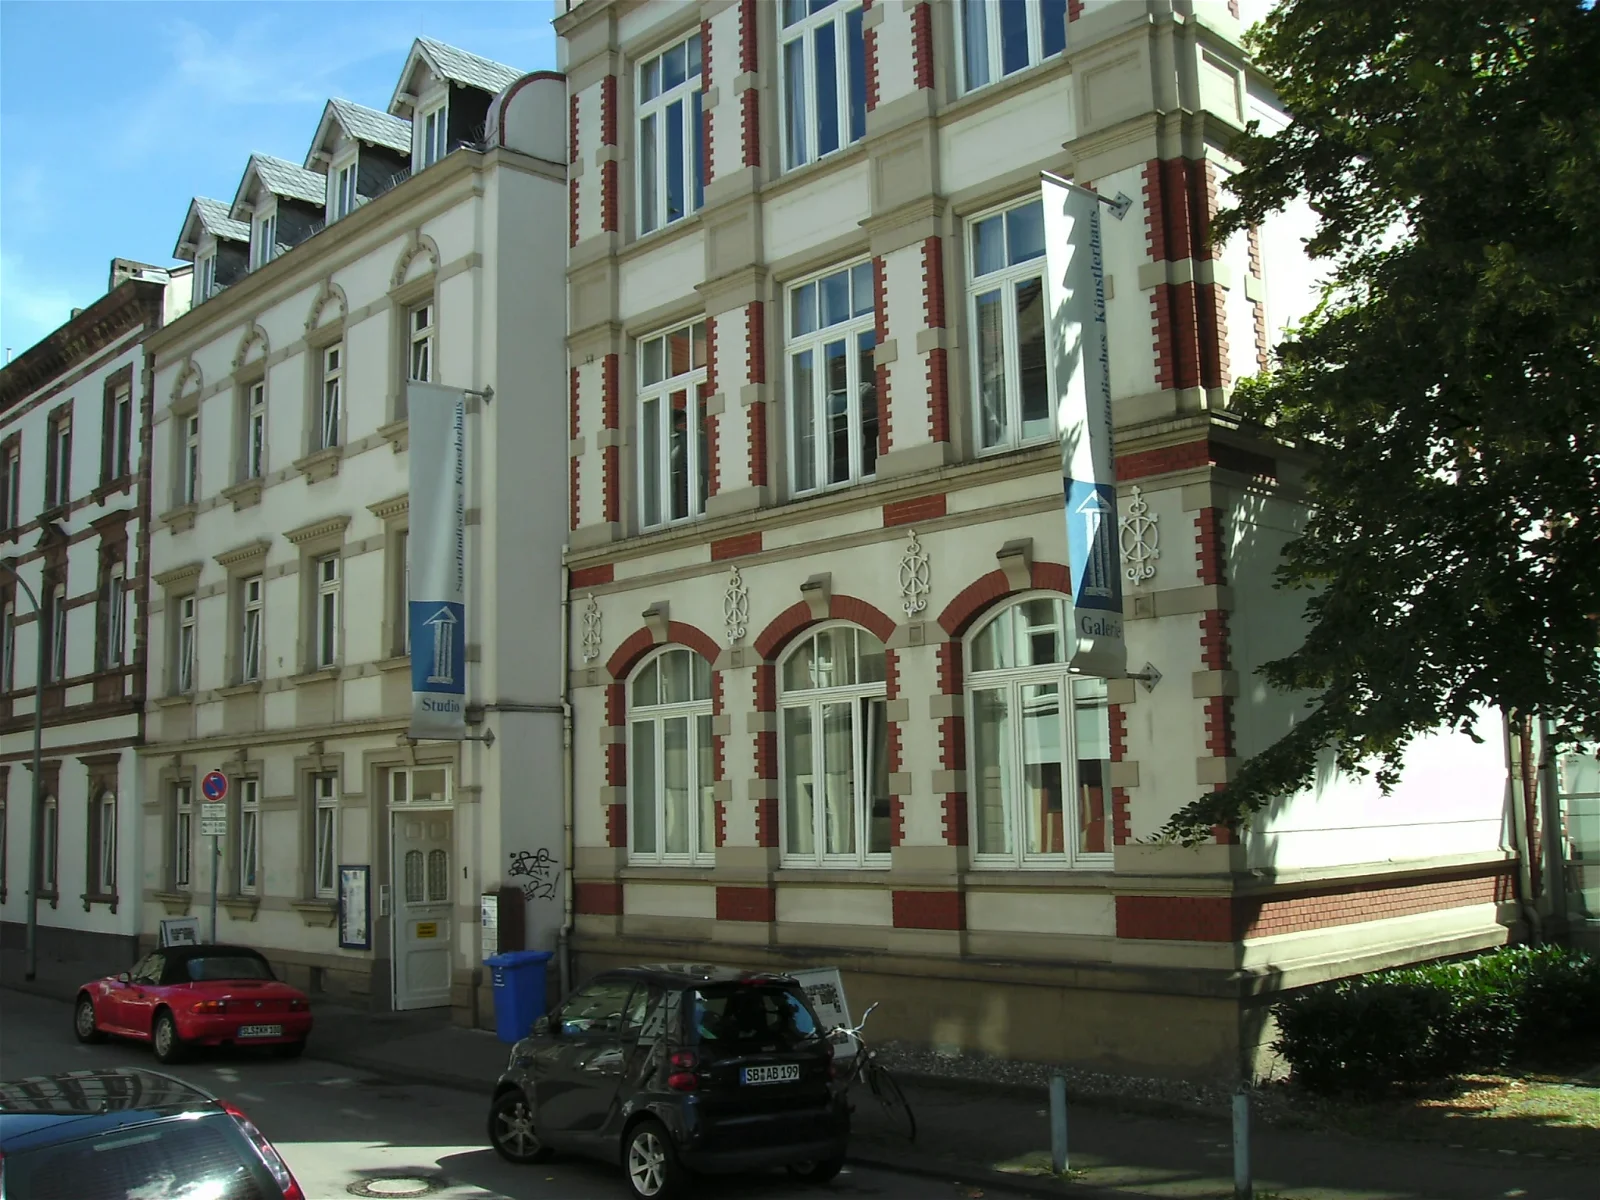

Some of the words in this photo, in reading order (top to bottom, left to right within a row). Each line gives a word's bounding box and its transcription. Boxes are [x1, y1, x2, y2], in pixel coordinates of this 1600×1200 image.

[1088, 209, 1106, 323] Künstlerhaus
[453, 400, 464, 486] Künstlerhaus
[454, 493, 464, 593] Saarländisches
[1081, 616, 1121, 638] Galerie
[421, 697, 460, 713] Studio
[462, 866, 468, 879] 1
[747, 1068, 760, 1081] SB
[766, 1067, 779, 1080] AB
[780, 1065, 798, 1079] 199
